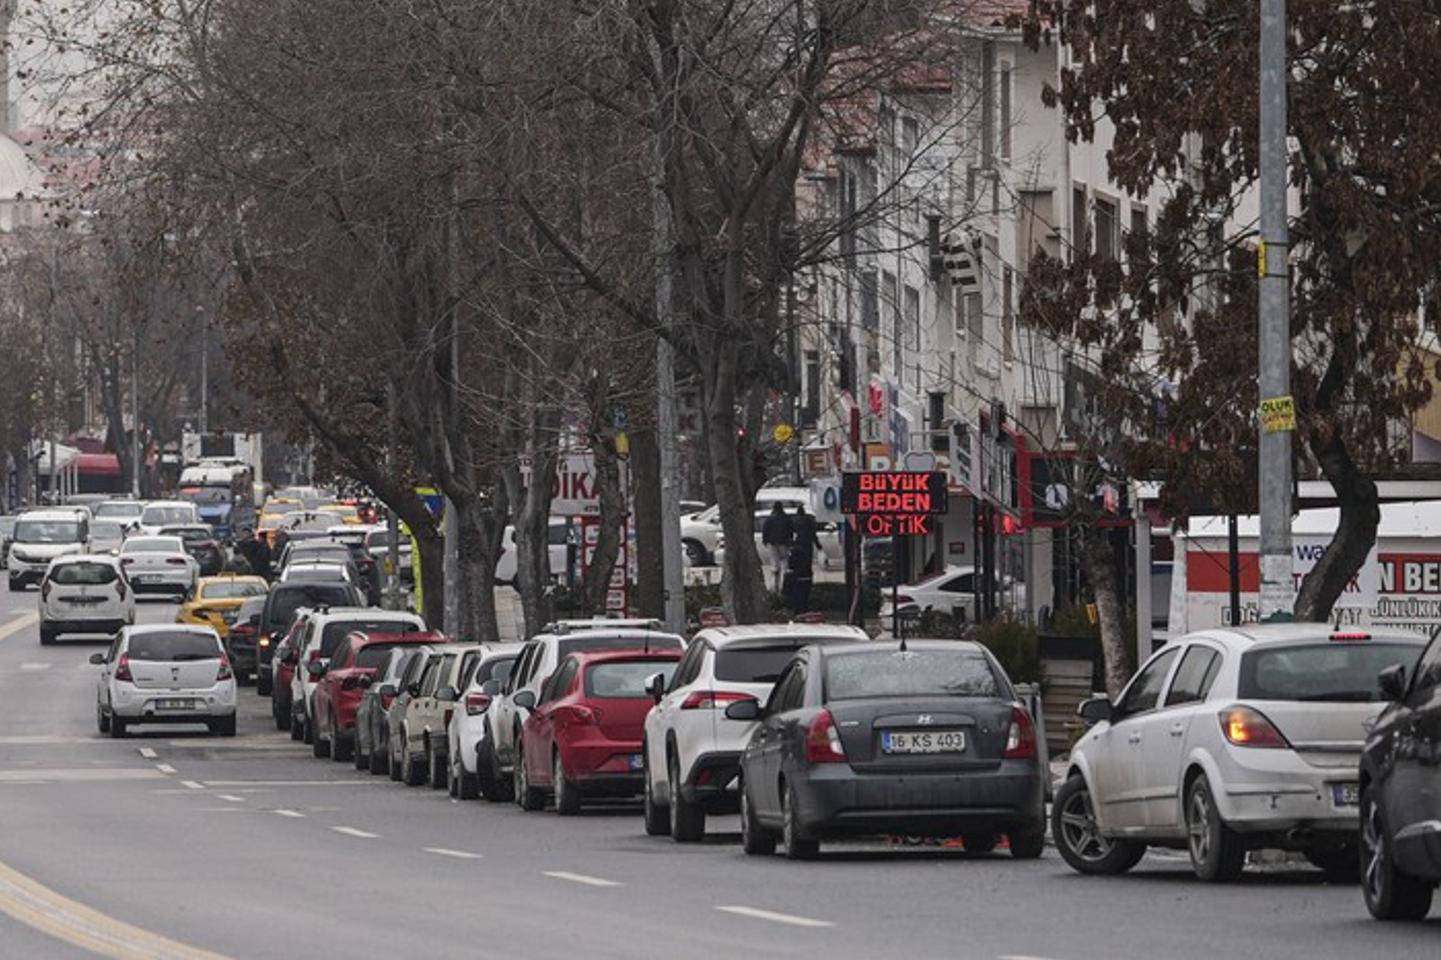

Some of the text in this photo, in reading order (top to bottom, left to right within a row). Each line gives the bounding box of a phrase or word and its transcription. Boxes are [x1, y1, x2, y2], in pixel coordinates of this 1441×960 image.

[858, 493, 931, 511] BEDEN
[1404, 562, 1441, 592] BE
[912, 734, 932, 748] KS
[936, 733, 963, 747] 403
